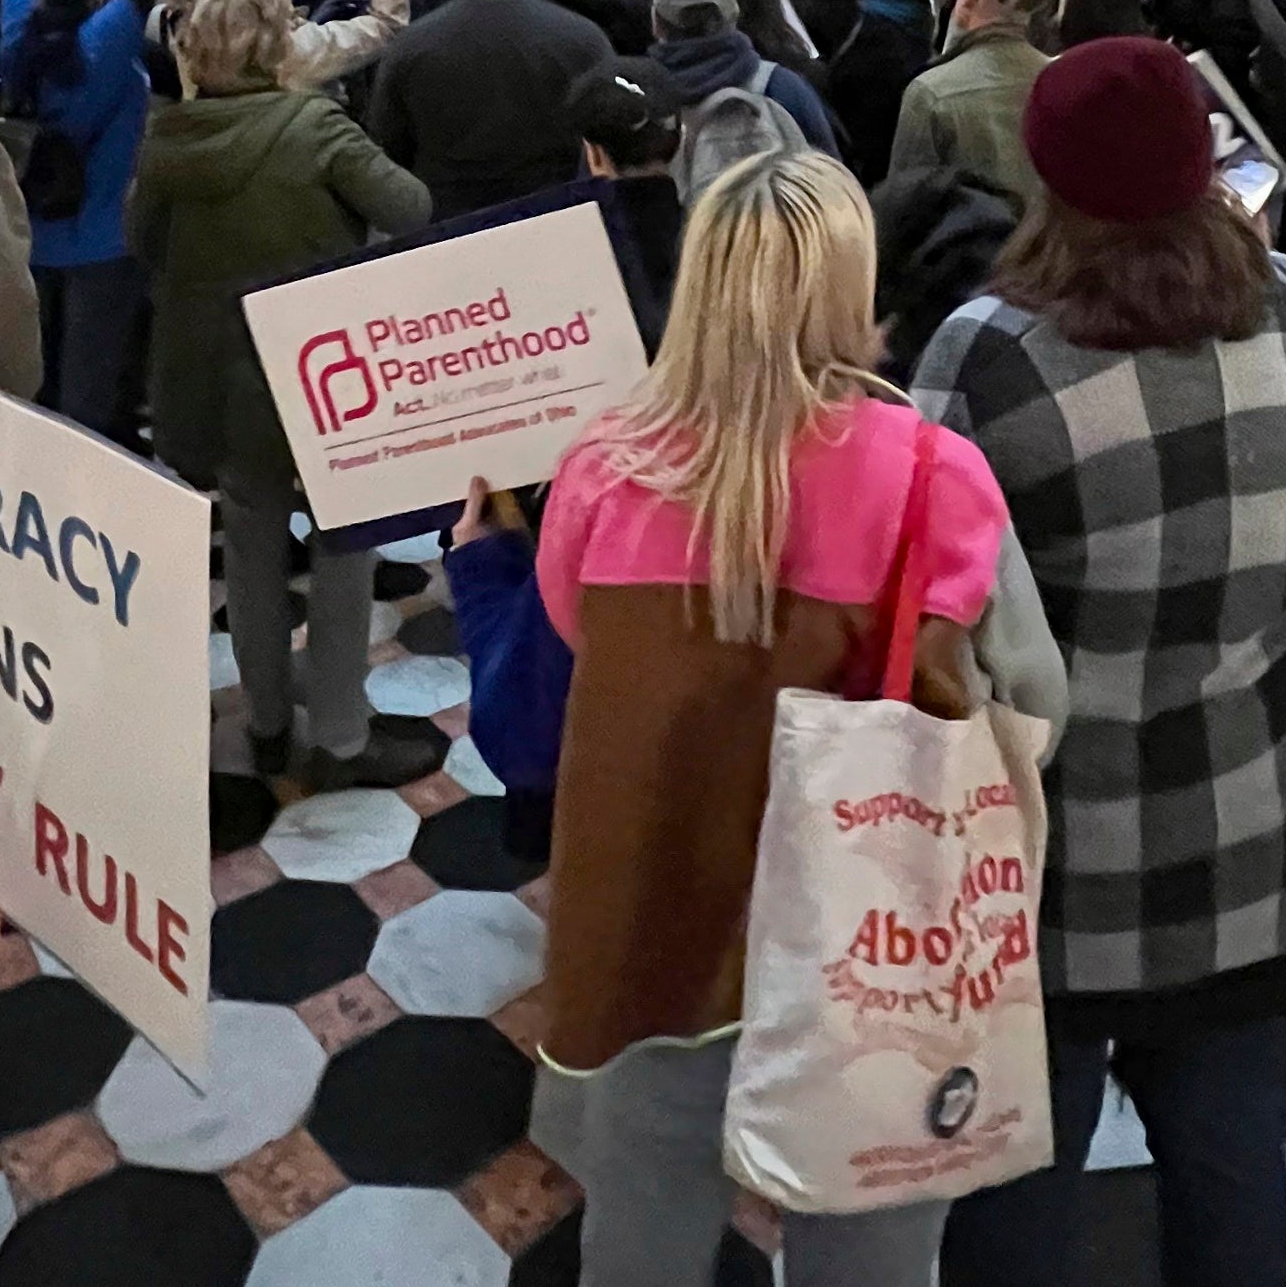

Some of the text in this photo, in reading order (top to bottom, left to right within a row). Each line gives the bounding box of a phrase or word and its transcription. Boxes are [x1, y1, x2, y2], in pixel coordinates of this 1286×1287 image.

[364, 287, 512, 353] Planned
[378, 310, 592, 392] Parenthood
[33, 801, 190, 997] RULE
